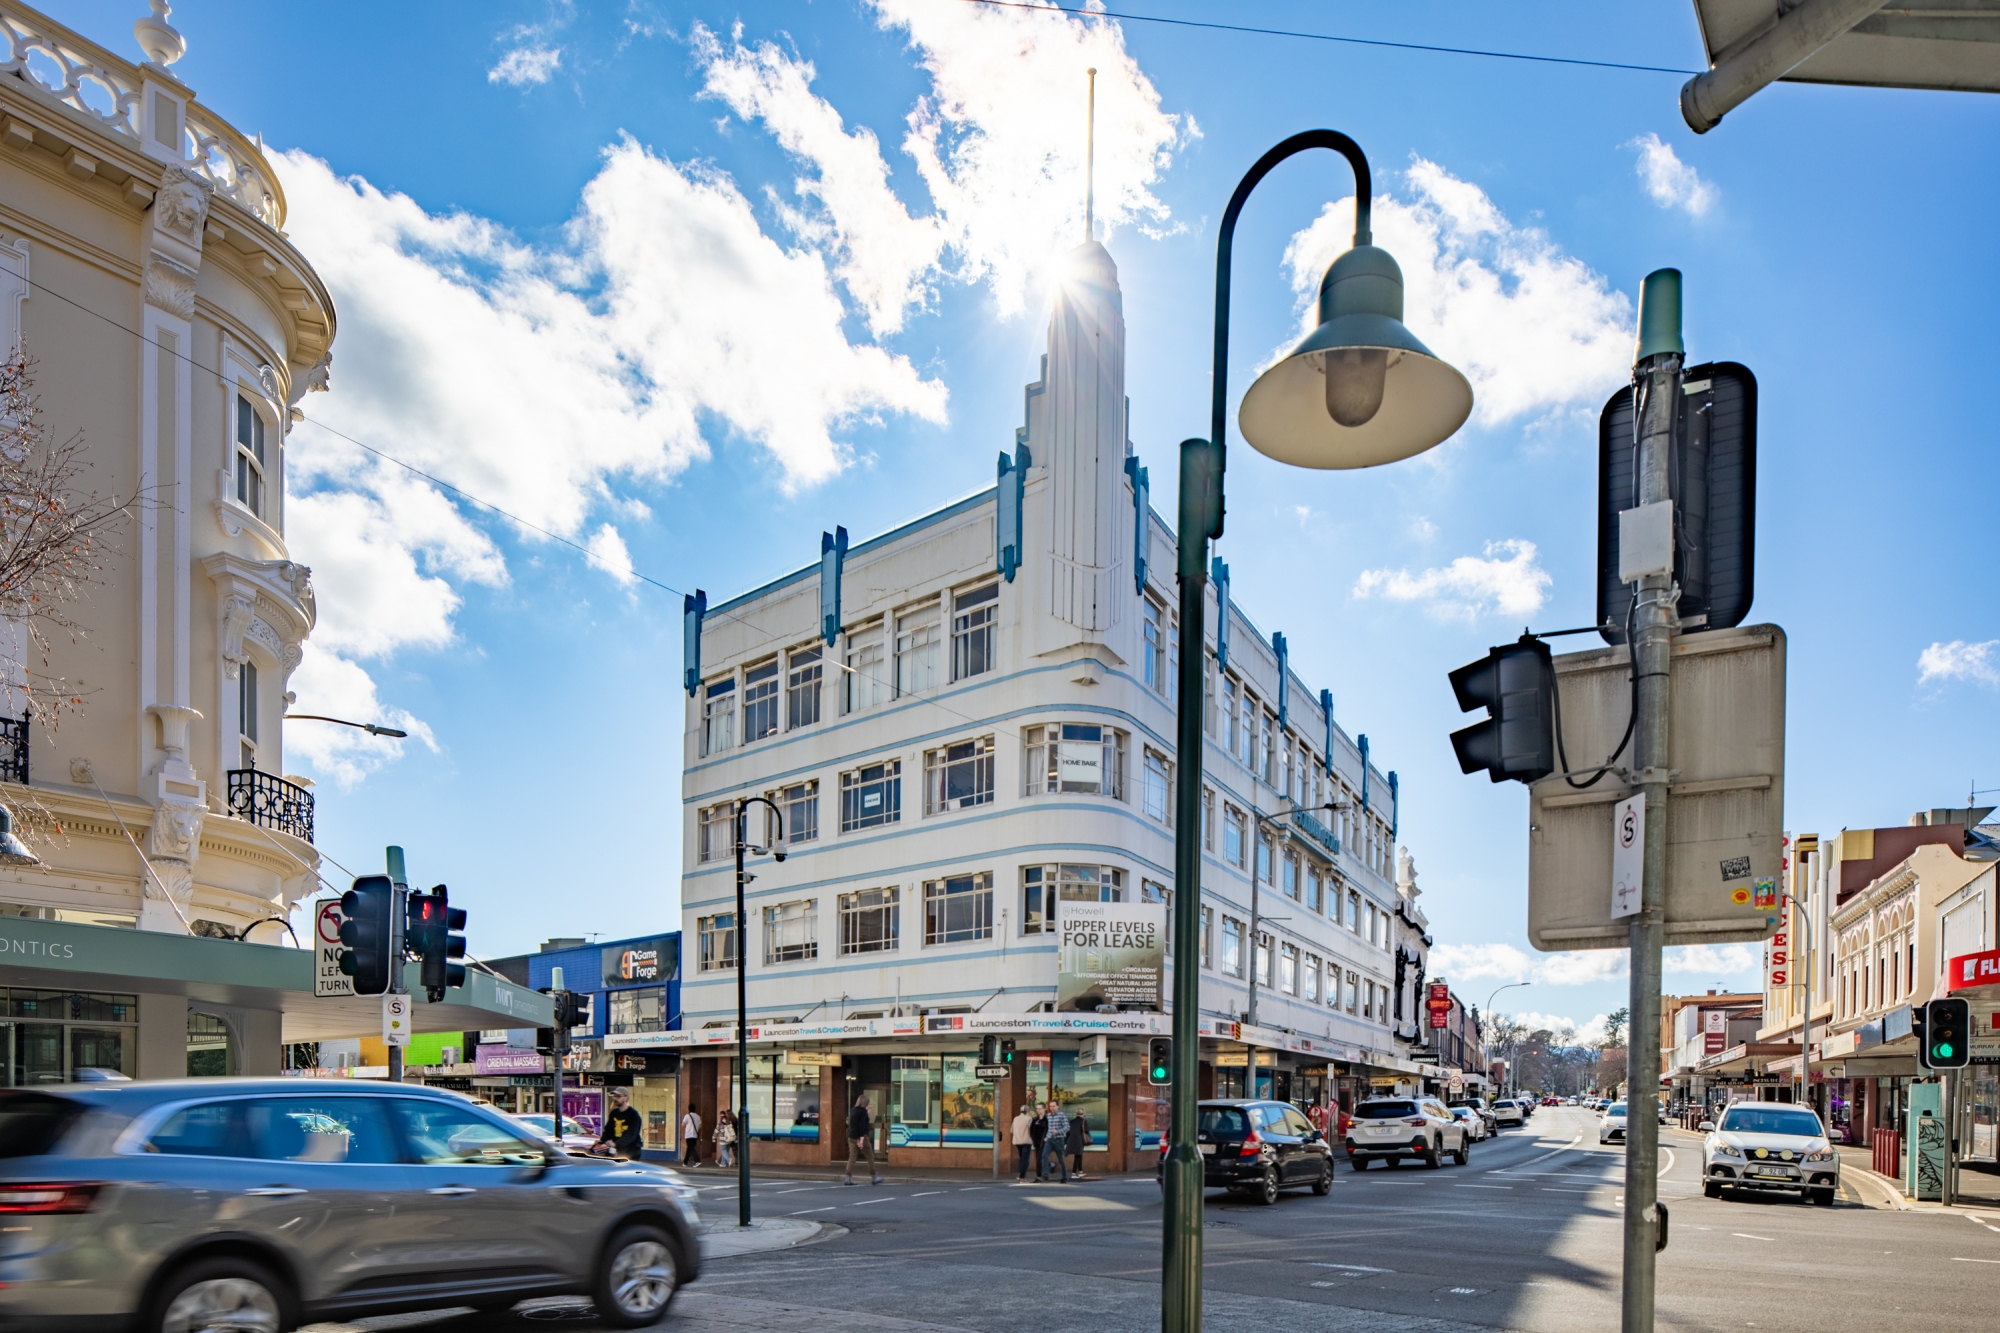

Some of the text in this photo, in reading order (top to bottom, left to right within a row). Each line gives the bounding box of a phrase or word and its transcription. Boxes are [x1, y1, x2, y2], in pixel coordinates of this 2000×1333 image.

[1071, 907, 1104, 915] Howell
[1063, 920, 1155, 933] UPPER LEVELS
[1063, 932, 1155, 949] FOR LEASE
[637, 950, 657, 960] Game
[636, 967, 657, 979] Forge
[320, 981, 349, 990] TURN
[496, 980, 513, 1015] ivory
[392, 1003, 401, 1013] S
[487, 1056, 540, 1068] ORIENTAL MASSAGE
[514, 1077, 555, 1085] MASSAG
